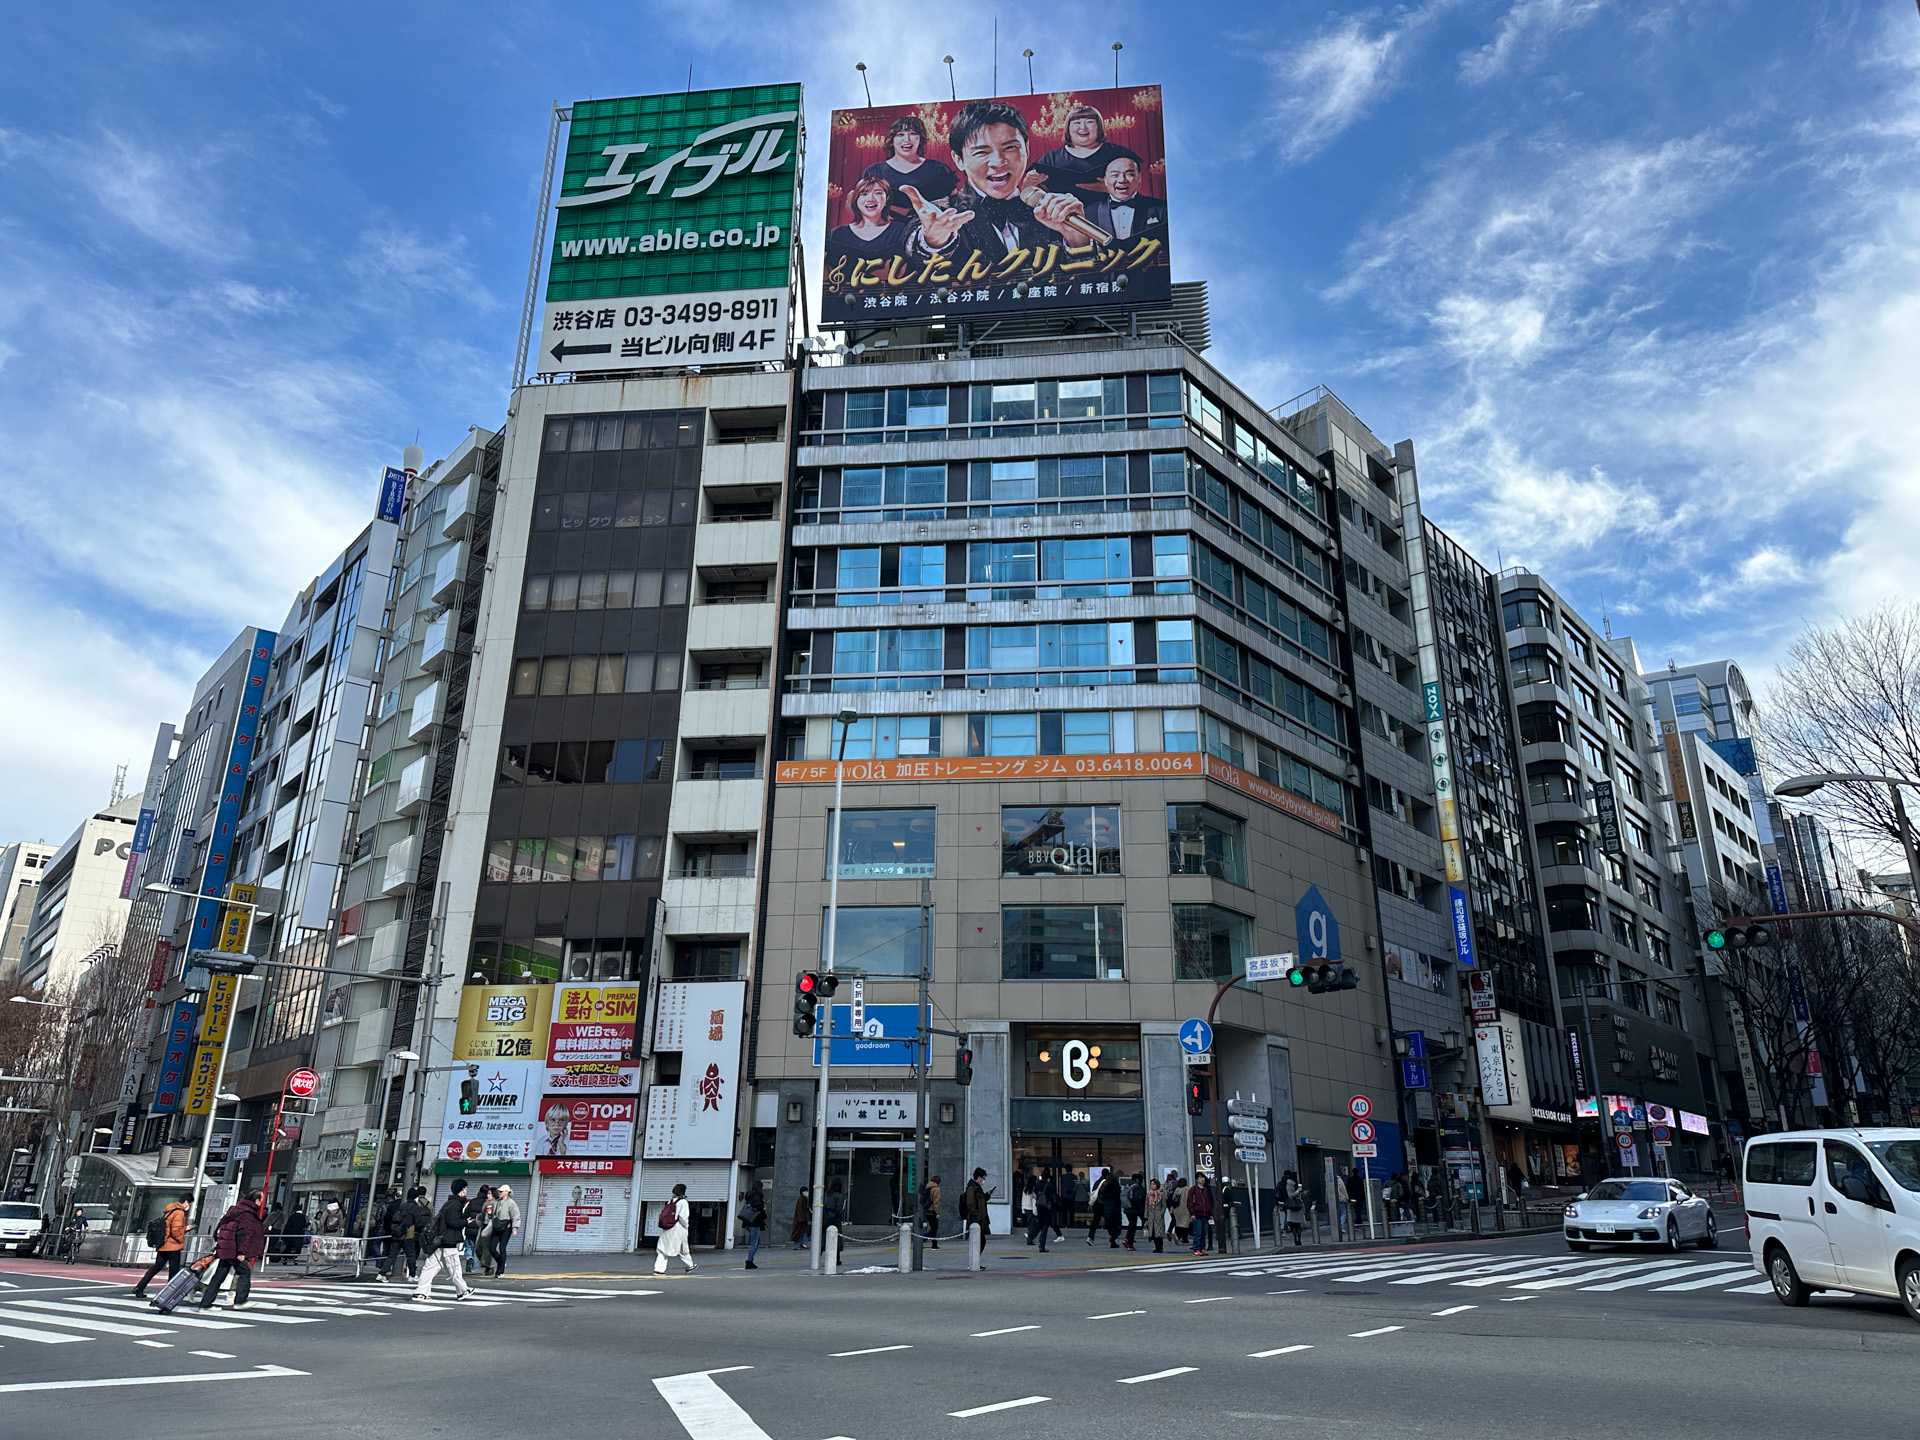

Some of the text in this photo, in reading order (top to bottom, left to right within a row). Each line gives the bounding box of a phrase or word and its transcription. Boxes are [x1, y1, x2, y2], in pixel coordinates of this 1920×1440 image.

[568, 113, 796, 204] エイブル
[560, 222, 780, 257] www.able.co.jp
[850, 236, 1162, 287] にしたん クリニック
[864, 294, 908, 308] 渋谷院
[553, 298, 778, 331] 渋谷店 03-3499-8911
[620, 329, 776, 358] 当ビル向側 4F
[1427, 686, 1440, 719] NOVA
[896, 760, 1028, 777] 加圧トレーニング
[1034, 758, 1067, 774] ジム
[1076, 757, 1194, 772] 03.6418.0064
[1247, 779, 1337, 829] www.bodybyvital.jp/ola/
[236, 890, 251, 902] EST
[227, 917, 240, 936] 卓球
[237, 919, 248, 947] PING PONG
[1249, 956, 1289, 971] 宮益坂下
[488, 996, 527, 1007] MEGA
[566, 991, 593, 1006] 法人
[854, 980, 862, 1027] 右折車専用
[208, 980, 227, 1037] ビリヤード
[220, 992, 232, 1026] BILLIARD
[486, 1007, 526, 1021] BIG
[565, 1006, 593, 1020] 受付
[605, 1001, 636, 1017] SIM
[575, 1026, 618, 1037] WEBでも
[469, 1040, 496, 1048] くじ史上
[495, 1038, 533, 1057] 12億
[555, 1038, 633, 1050] 無料相談実施中
[855, 1042, 890, 1050] goodroom
[1569, 1032, 1581, 1069] EXCELSIOR
[158, 1009, 191, 1106] カラオケ館
[565, 1064, 620, 1074] スマホのことは
[1490, 1044, 1504, 1097] 東京たらこ
[192, 1051, 214, 1110] ボウリング
[205, 1062, 218, 1100] BOWLING
[292, 1077, 314, 1090] 消火栓
[549, 1074, 633, 1087] スマホ相談窓口へ!
[1481, 1056, 1495, 1100] スパゲティ
[590, 1103, 632, 1119] TOP1
[838, 1109, 907, 1120] 小林ビル
[1354, 1101, 1367, 1112] 40
[1531, 1107, 1557, 1120] EXCELSIOR
[1062, 1110, 1091, 1122] b8ta
[557, 1161, 613, 1170] スマホ相談窓口
